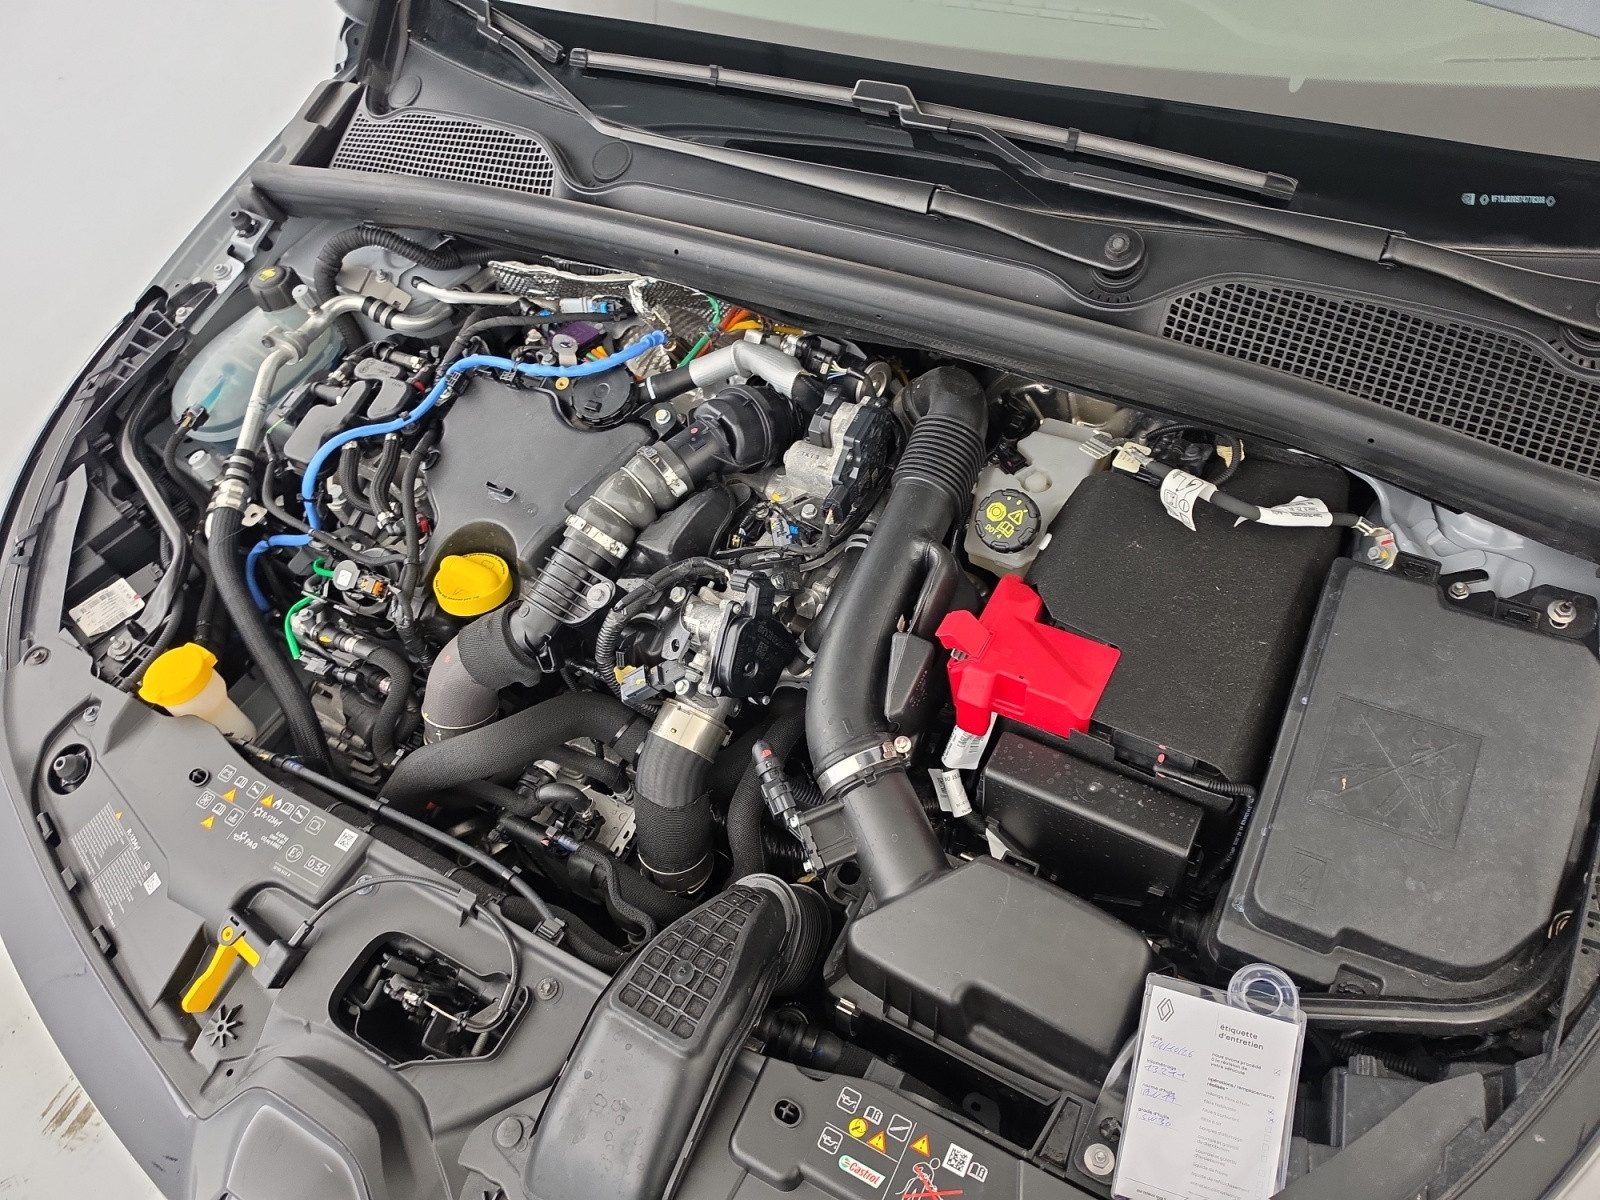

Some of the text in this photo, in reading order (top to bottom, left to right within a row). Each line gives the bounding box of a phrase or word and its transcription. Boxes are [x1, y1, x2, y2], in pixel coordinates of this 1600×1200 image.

[985, 524, 999, 535] DOT
[260, 811, 283, 828] R-1234yf
[288, 847, 302, 859] E9
[307, 859, 327, 874] 0,54
[1220, 1024, 1258, 1040] étiquette
[1219, 1032, 1264, 1050] d'entretien
[850, 1162, 880, 1184] Castrol
